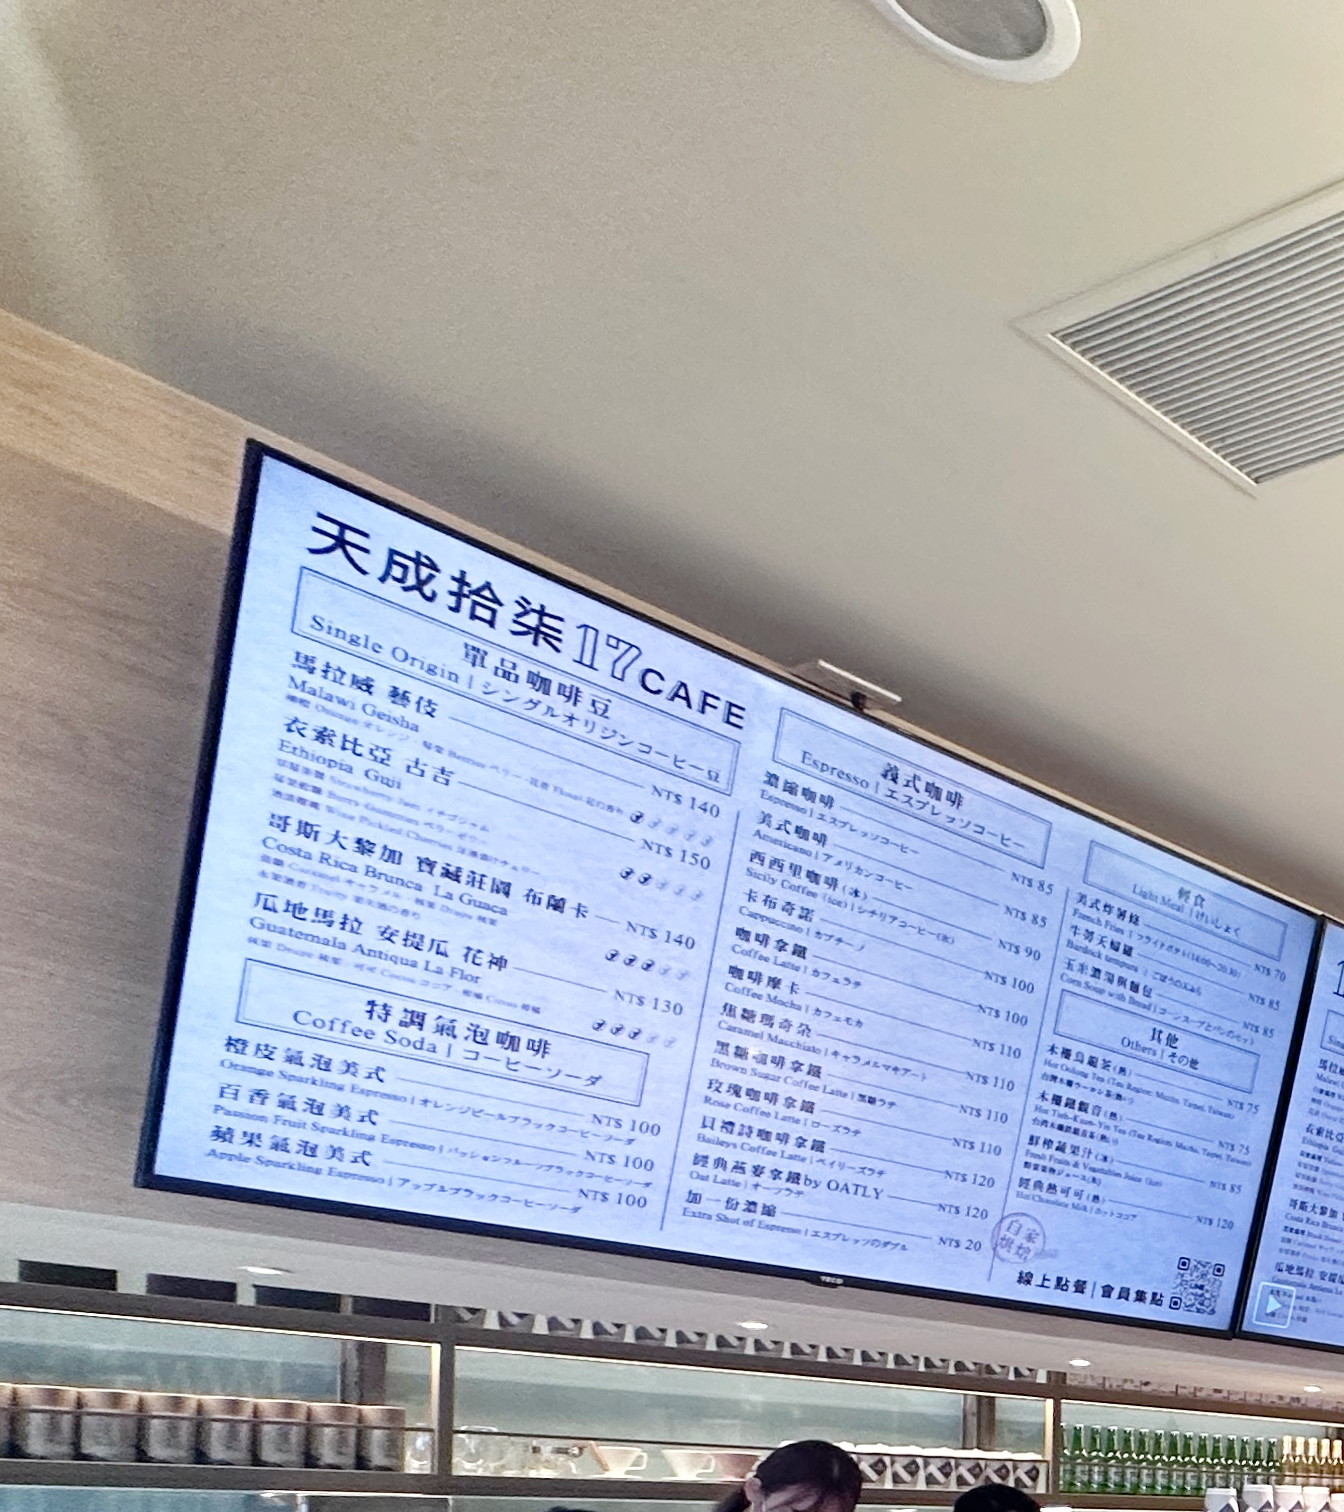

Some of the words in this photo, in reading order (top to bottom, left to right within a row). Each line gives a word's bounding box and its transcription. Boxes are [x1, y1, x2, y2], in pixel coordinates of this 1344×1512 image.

[305, 510, 566, 654] 天成拾柒
[309, 613, 384, 655] Single
[389, 645, 460, 685] Origin
[462, 641, 613, 721] 單品咖啡豆
[287, 673, 356, 711] Malawi
[360, 701, 420, 734] Geisha
[291, 650, 376, 697] 馬拉威
[688, 795, 721, 819] 140
[277, 737, 354, 775] Ethiopia
[362, 767, 402, 791] Guji
[799, 749, 870, 790] Espresso
[283, 715, 393, 768] 衣索比亞
[404, 756, 456, 787] 古吉
[679, 847, 712, 871] 150
[260, 835, 314, 862] Costa
[317, 850, 359, 874] Rica
[362, 863, 424, 893] Brunca
[432, 883, 455, 902] La
[756, 809, 828, 849] 美式咖啡
[1029, 912, 1048, 929] 85
[268, 812, 404, 866] 哥斯大黎加
[663, 929, 697, 951] 140
[779, 877, 819, 900] Coffee
[1035, 878, 1055, 897] 85
[1130, 882, 1159, 904] Light
[248, 915, 348, 952] Guatemala
[422, 958, 445, 976] La
[447, 965, 483, 985] Flor
[253, 891, 364, 936] 瓜地馬拉
[376, 924, 450, 959] 安提瓜
[461, 944, 509, 972] 花神
[651, 996, 684, 1017] 130
[729, 942, 771, 964] Coffee
[1023, 945, 1042, 962] 90
[1010, 976, 1035, 995] 100
[1273, 968, 1287, 984] 70
[723, 980, 764, 1001] Coffee
[1266, 997, 1281, 1012] 85
[363, 998, 552, 1060] 特調氣泡咖啡
[1004, 1009, 1029, 1028] 100
[1148, 1026, 1180, 1050] 其他
[1261, 1025, 1275, 1039] 85
[291, 1009, 377, 1041] Coffee
[382, 1028, 438, 1055] Soda
[462, 1048, 604, 1088] コーヒーソーダ
[998, 1042, 1022, 1060] 110
[1119, 1035, 1158, 1058] Others
[1166, 1050, 1200, 1071] その他
[991, 1074, 1016, 1093] 110
[731, 1101, 773, 1119] Coffee
[985, 1108, 1009, 1125] 110
[1245, 1101, 1261, 1115] 75
[628, 1118, 662, 1137] 100
[978, 1140, 1003, 1157] 110
[1237, 1142, 1251, 1156] 75
[622, 1154, 656, 1173] 100
[970, 1172, 996, 1189] 120
[1228, 1182, 1243, 1195] 85
[615, 1191, 648, 1210] 100
[825, 1178, 884, 1201] OATLY
[964, 1204, 989, 1221] 120
[1215, 1216, 1235, 1231] 120
[963, 1237, 983, 1253] 20
[1015, 1269, 1088, 1295] 線上點餐
[1099, 1282, 1165, 1308] 會員集點
